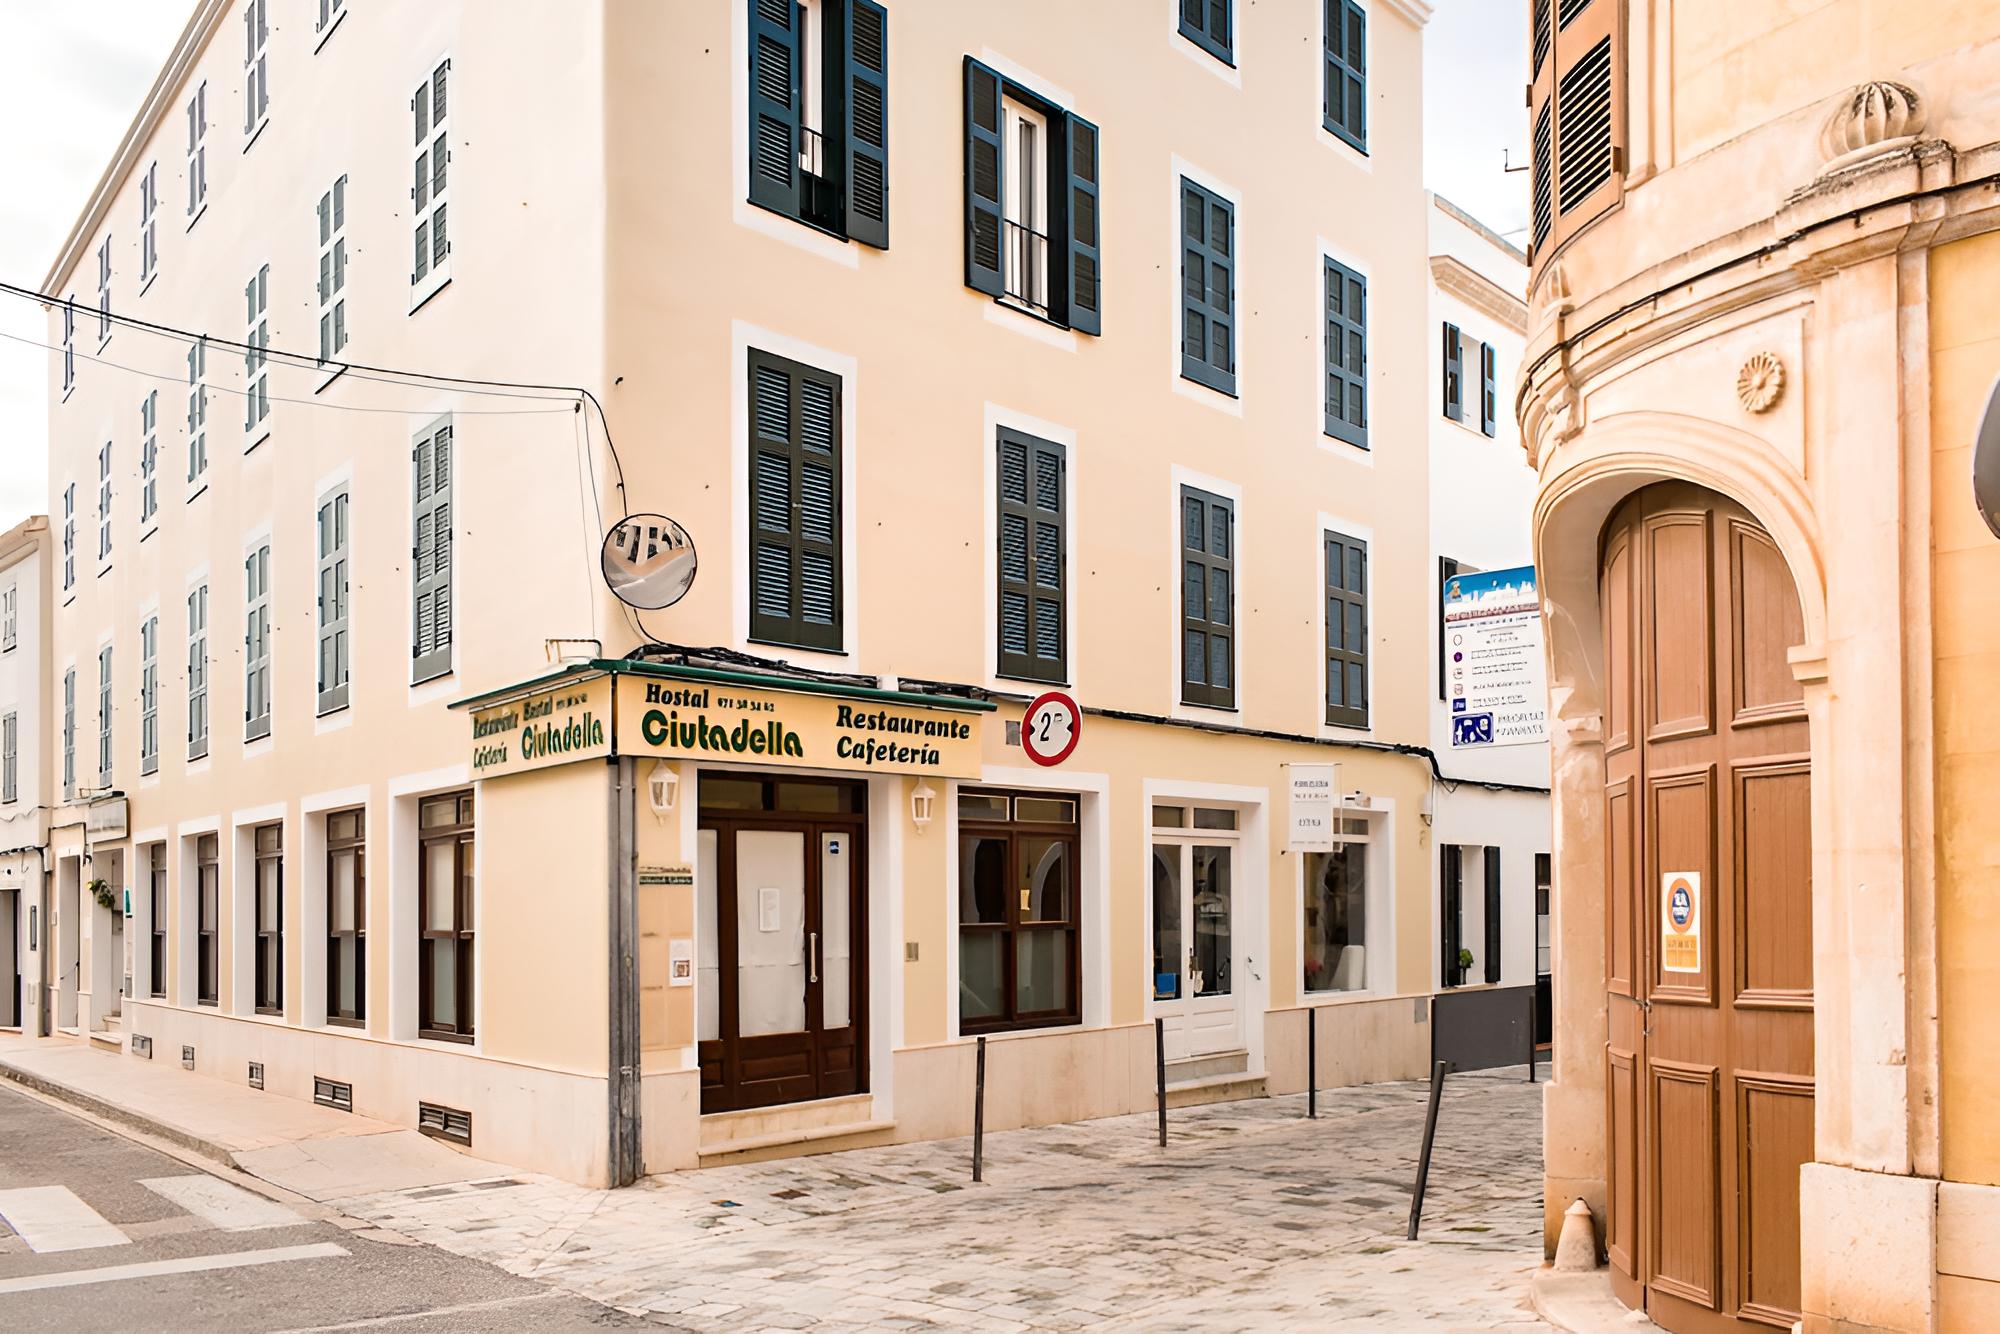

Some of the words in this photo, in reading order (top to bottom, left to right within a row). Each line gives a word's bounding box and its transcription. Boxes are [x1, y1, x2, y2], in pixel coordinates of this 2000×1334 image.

[645, 683, 709, 708] Hostal
[521, 711, 604, 760] Ciutadella
[641, 709, 804, 758] Ciutadella
[836, 704, 970, 739] Restaurante
[836, 735, 940, 765] Cafetería
